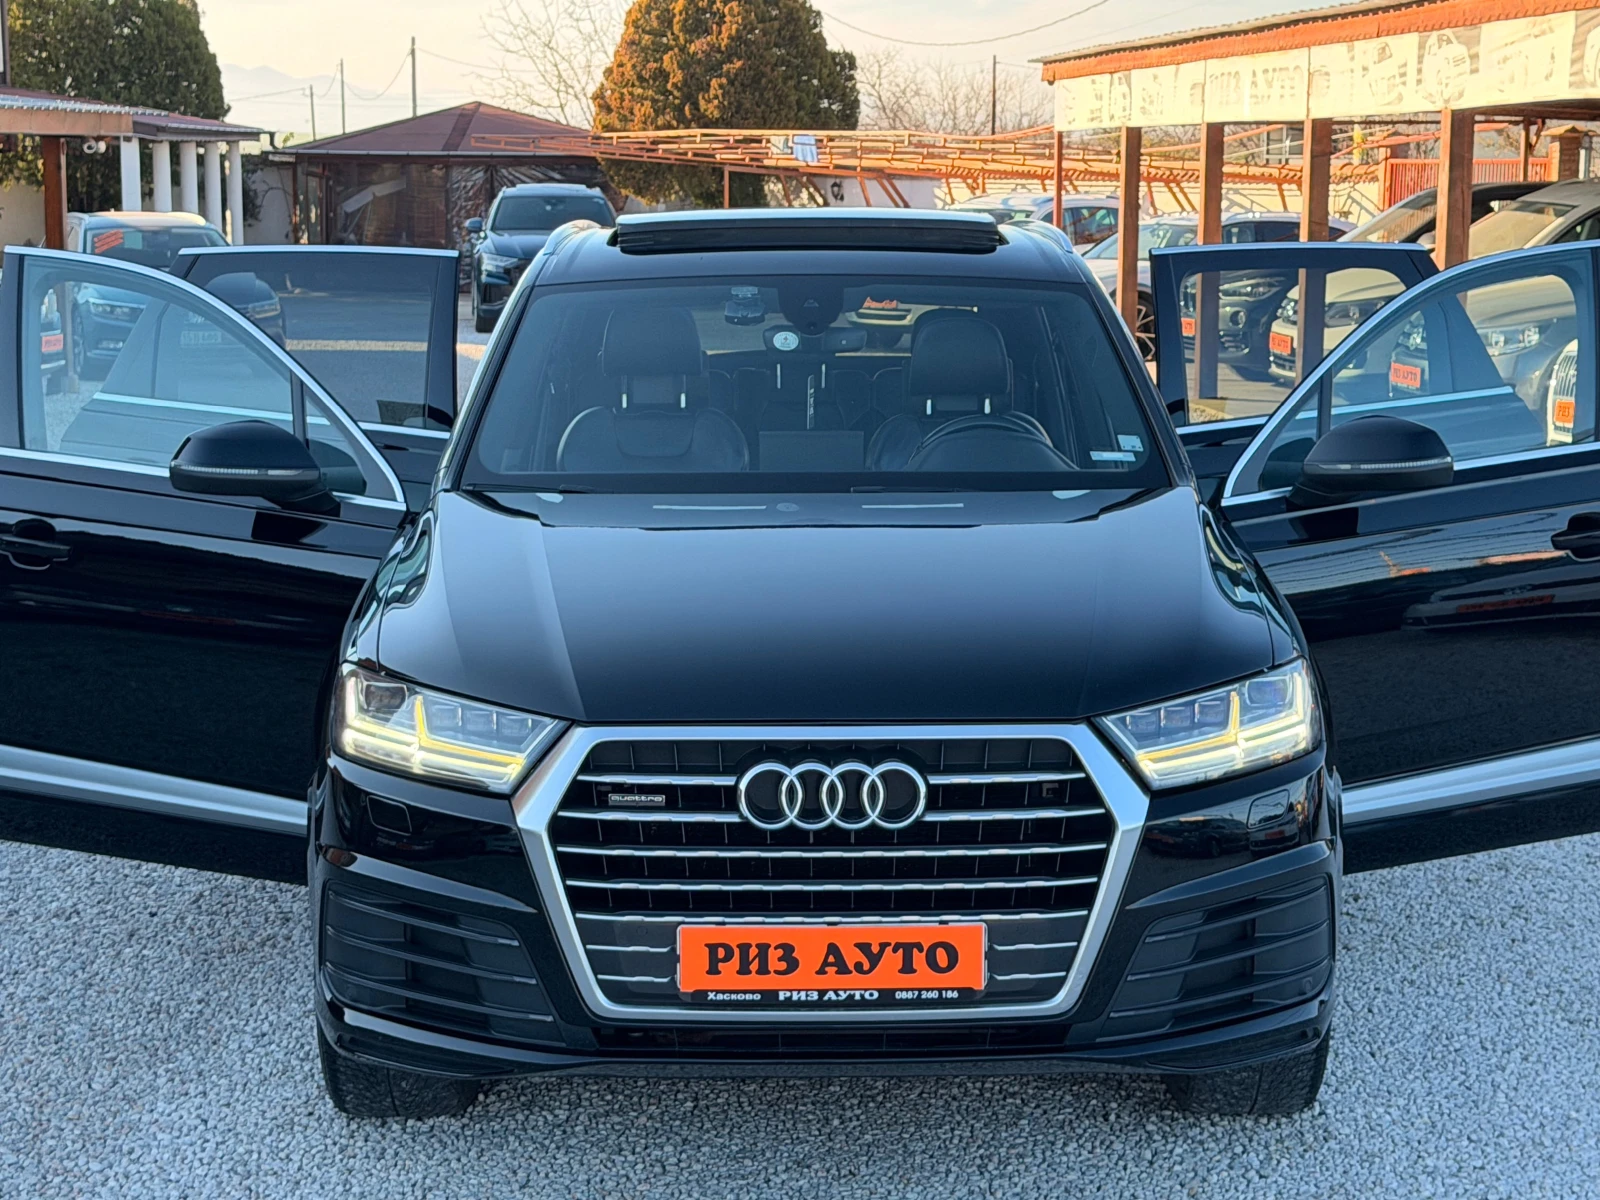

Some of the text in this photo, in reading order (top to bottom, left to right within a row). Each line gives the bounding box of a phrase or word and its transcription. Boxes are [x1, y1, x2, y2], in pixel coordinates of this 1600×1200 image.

[704, 941, 959, 975] РИЗ АУТО
[707, 991, 762, 1000] Хасково
[778, 990, 819, 1001] РИЗ
[822, 990, 879, 1000] АУТО
[895, 990, 918, 999] 0887
[921, 990, 939, 999] 260
